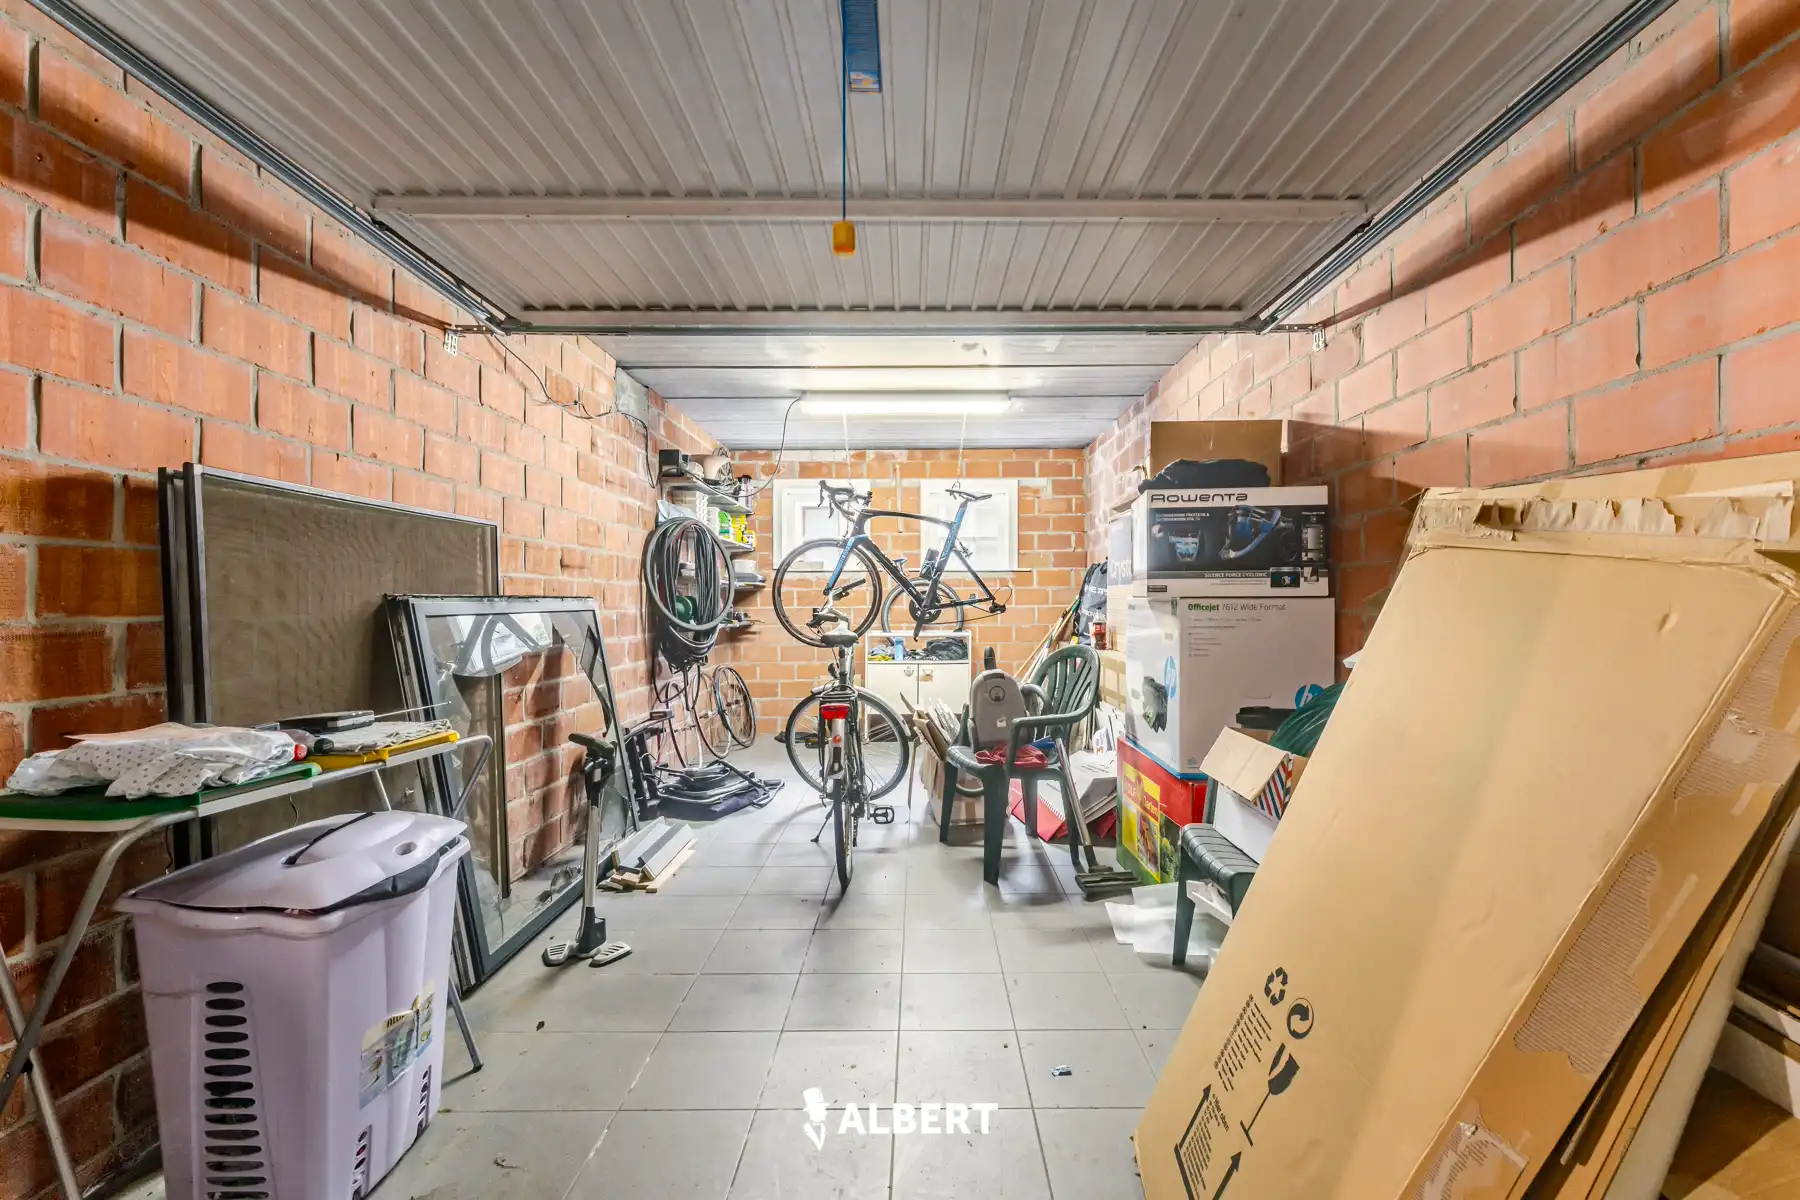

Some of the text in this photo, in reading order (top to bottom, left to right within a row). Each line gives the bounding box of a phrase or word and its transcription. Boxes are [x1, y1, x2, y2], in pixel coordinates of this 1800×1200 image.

[1187, 603, 1286, 612] Officejet 7612 Wide Format
